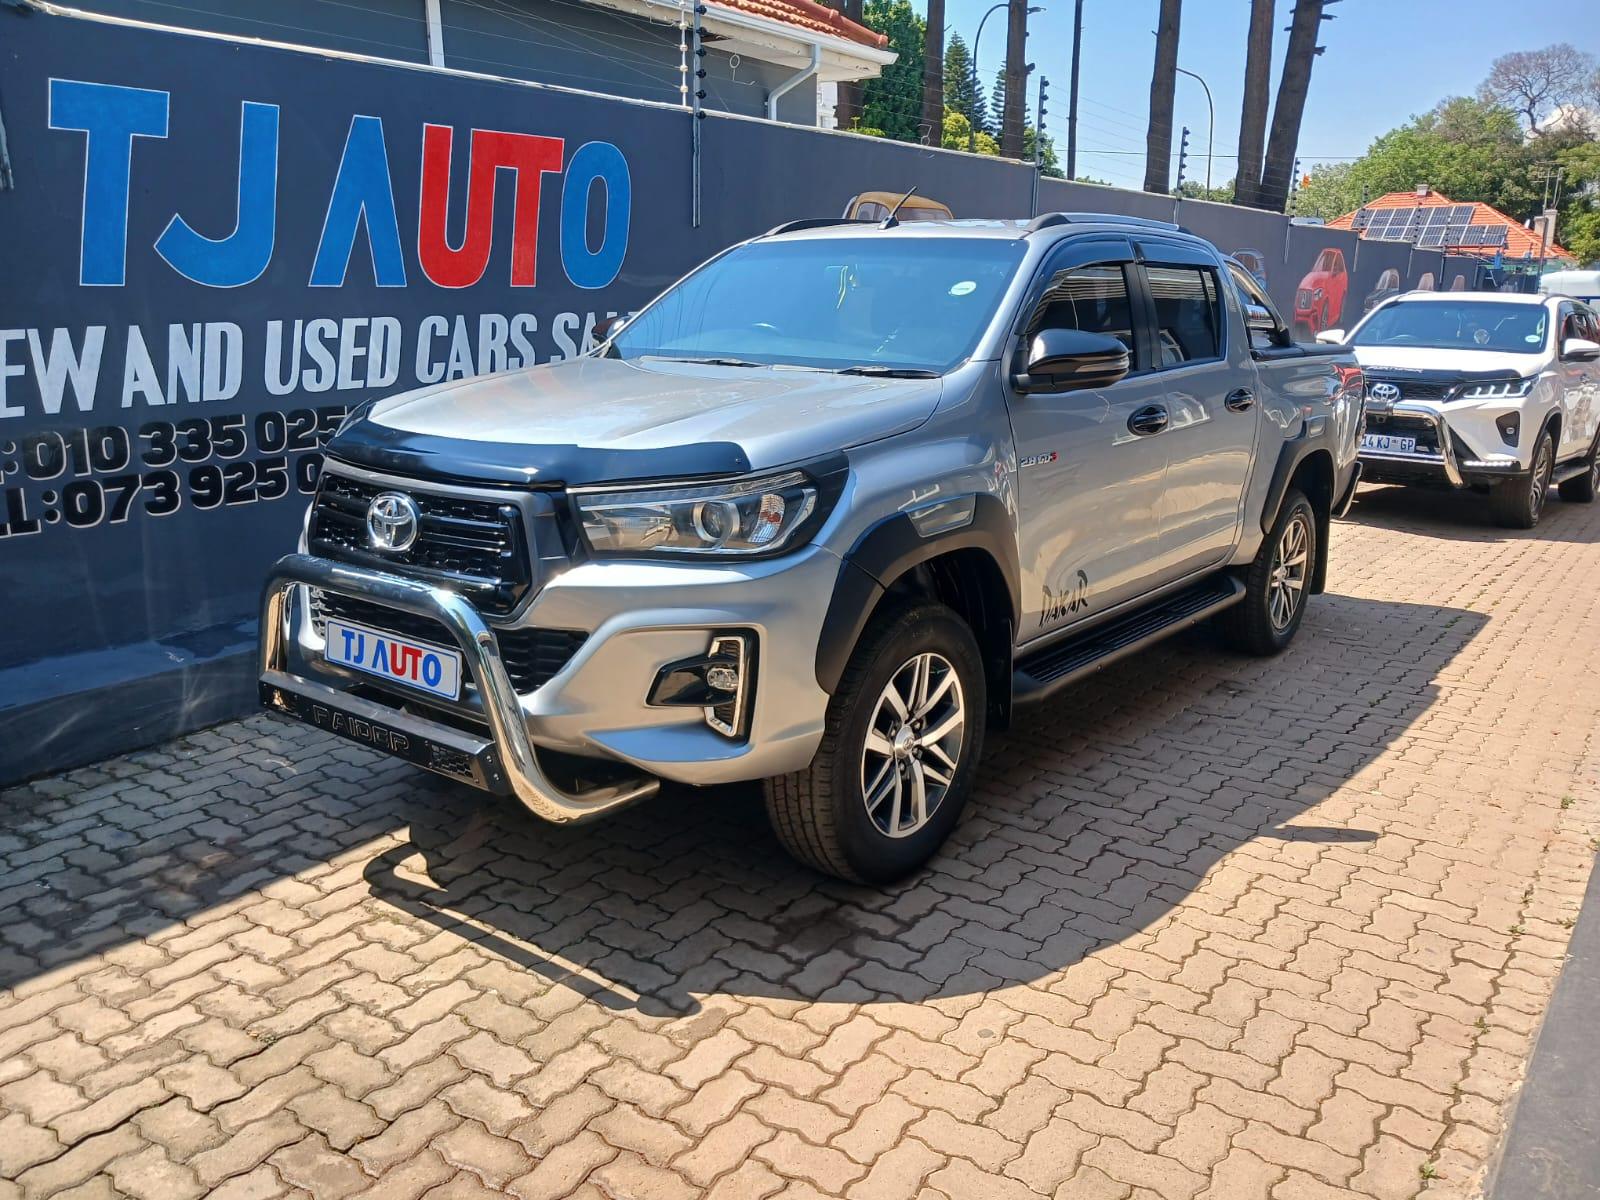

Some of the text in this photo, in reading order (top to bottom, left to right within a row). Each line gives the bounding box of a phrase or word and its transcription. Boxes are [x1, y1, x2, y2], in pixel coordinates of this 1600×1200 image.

[48, 77, 632, 289] TJ AUTO
[121, 321, 244, 408] AND
[264, 316, 402, 395] USED
[415, 313, 538, 384] CARS
[551, 311, 641, 361] SA
[0, 426, 131, 485] :010
[139, 414, 248, 468] 335
[1376, 436, 1391, 449] KJ
[1400, 438, 1415, 451] GP
[0, 470, 182, 538] L:073
[189, 456, 290, 510] 925
[341, 628, 442, 687] TJ AUTO
